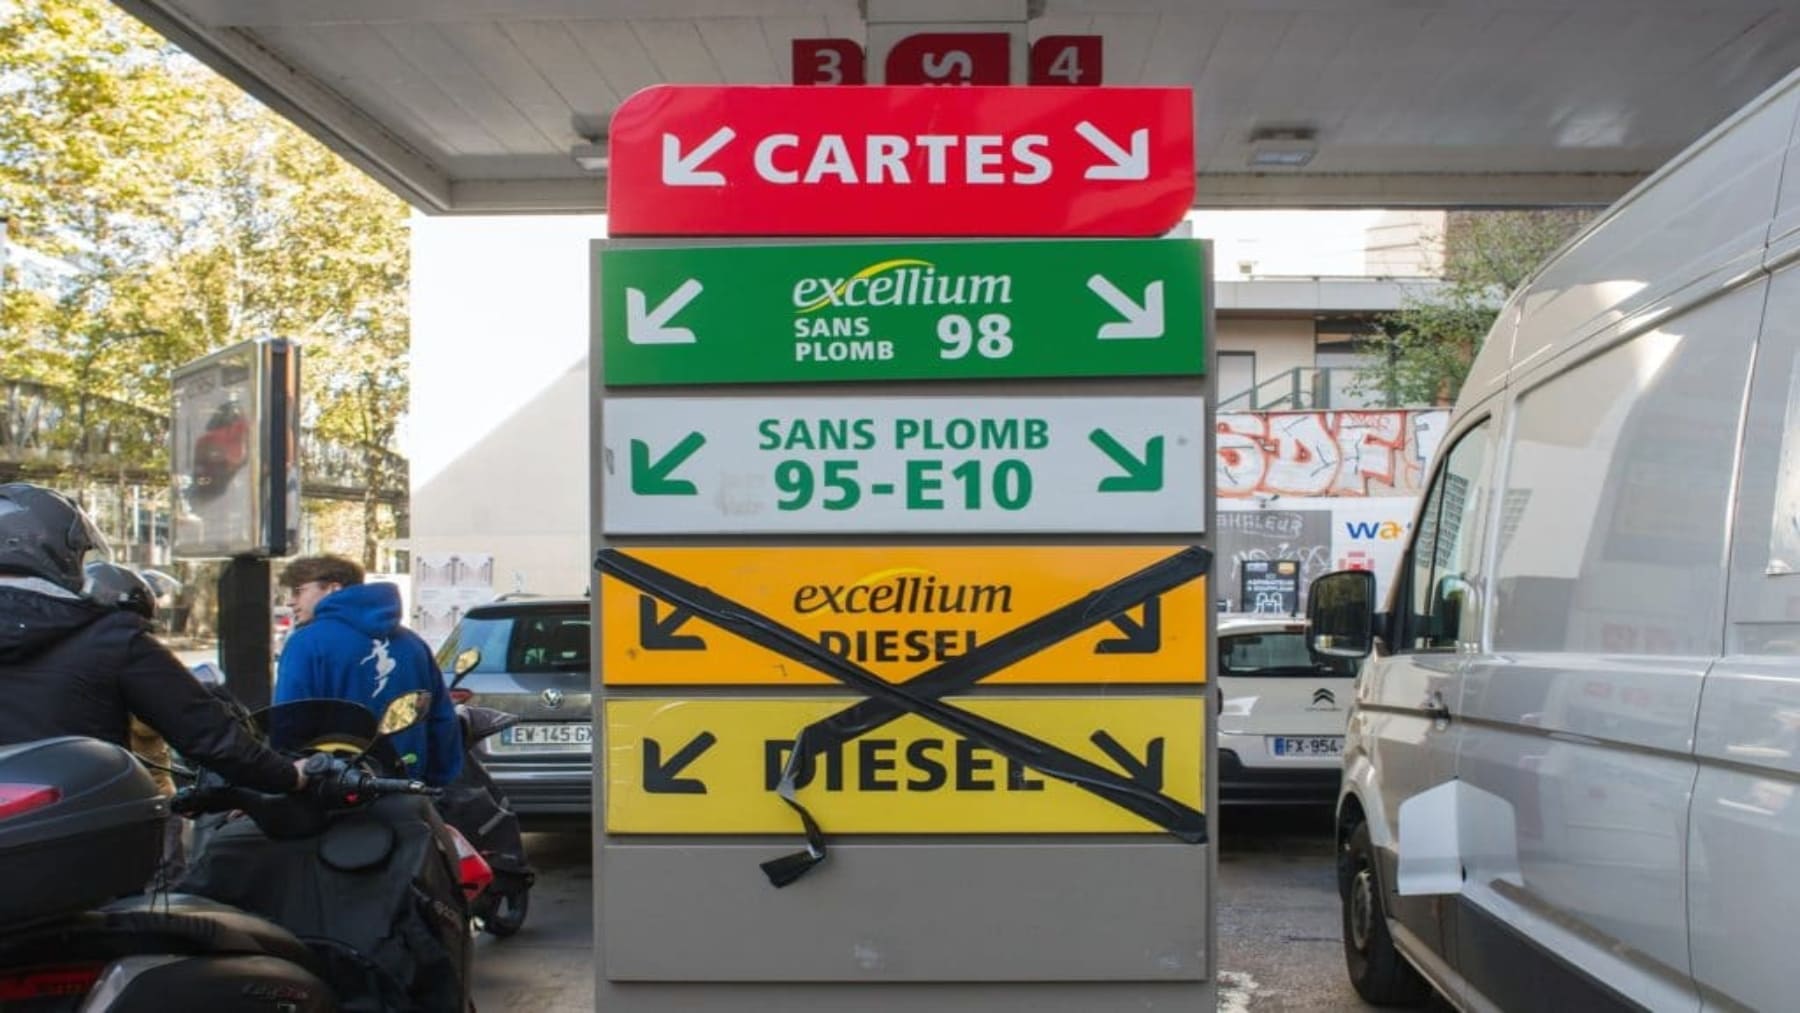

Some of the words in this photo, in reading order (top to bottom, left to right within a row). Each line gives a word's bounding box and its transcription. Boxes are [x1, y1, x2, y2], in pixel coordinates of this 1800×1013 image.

[814, 48, 843, 85] 3
[1048, 45, 1084, 84] 4
[753, 133, 1053, 185] CARTES
[792, 265, 1013, 309] excellium
[794, 317, 870, 338] SANS
[936, 313, 1014, 361] 98
[794, 341, 894, 362] PLOMB
[758, 418, 876, 450] SANS
[895, 418, 1049, 450] PLOMB
[773, 458, 1034, 512] 95-E10
[793, 574, 1013, 615] excellium
[764, 738, 1045, 792] DIESEL
